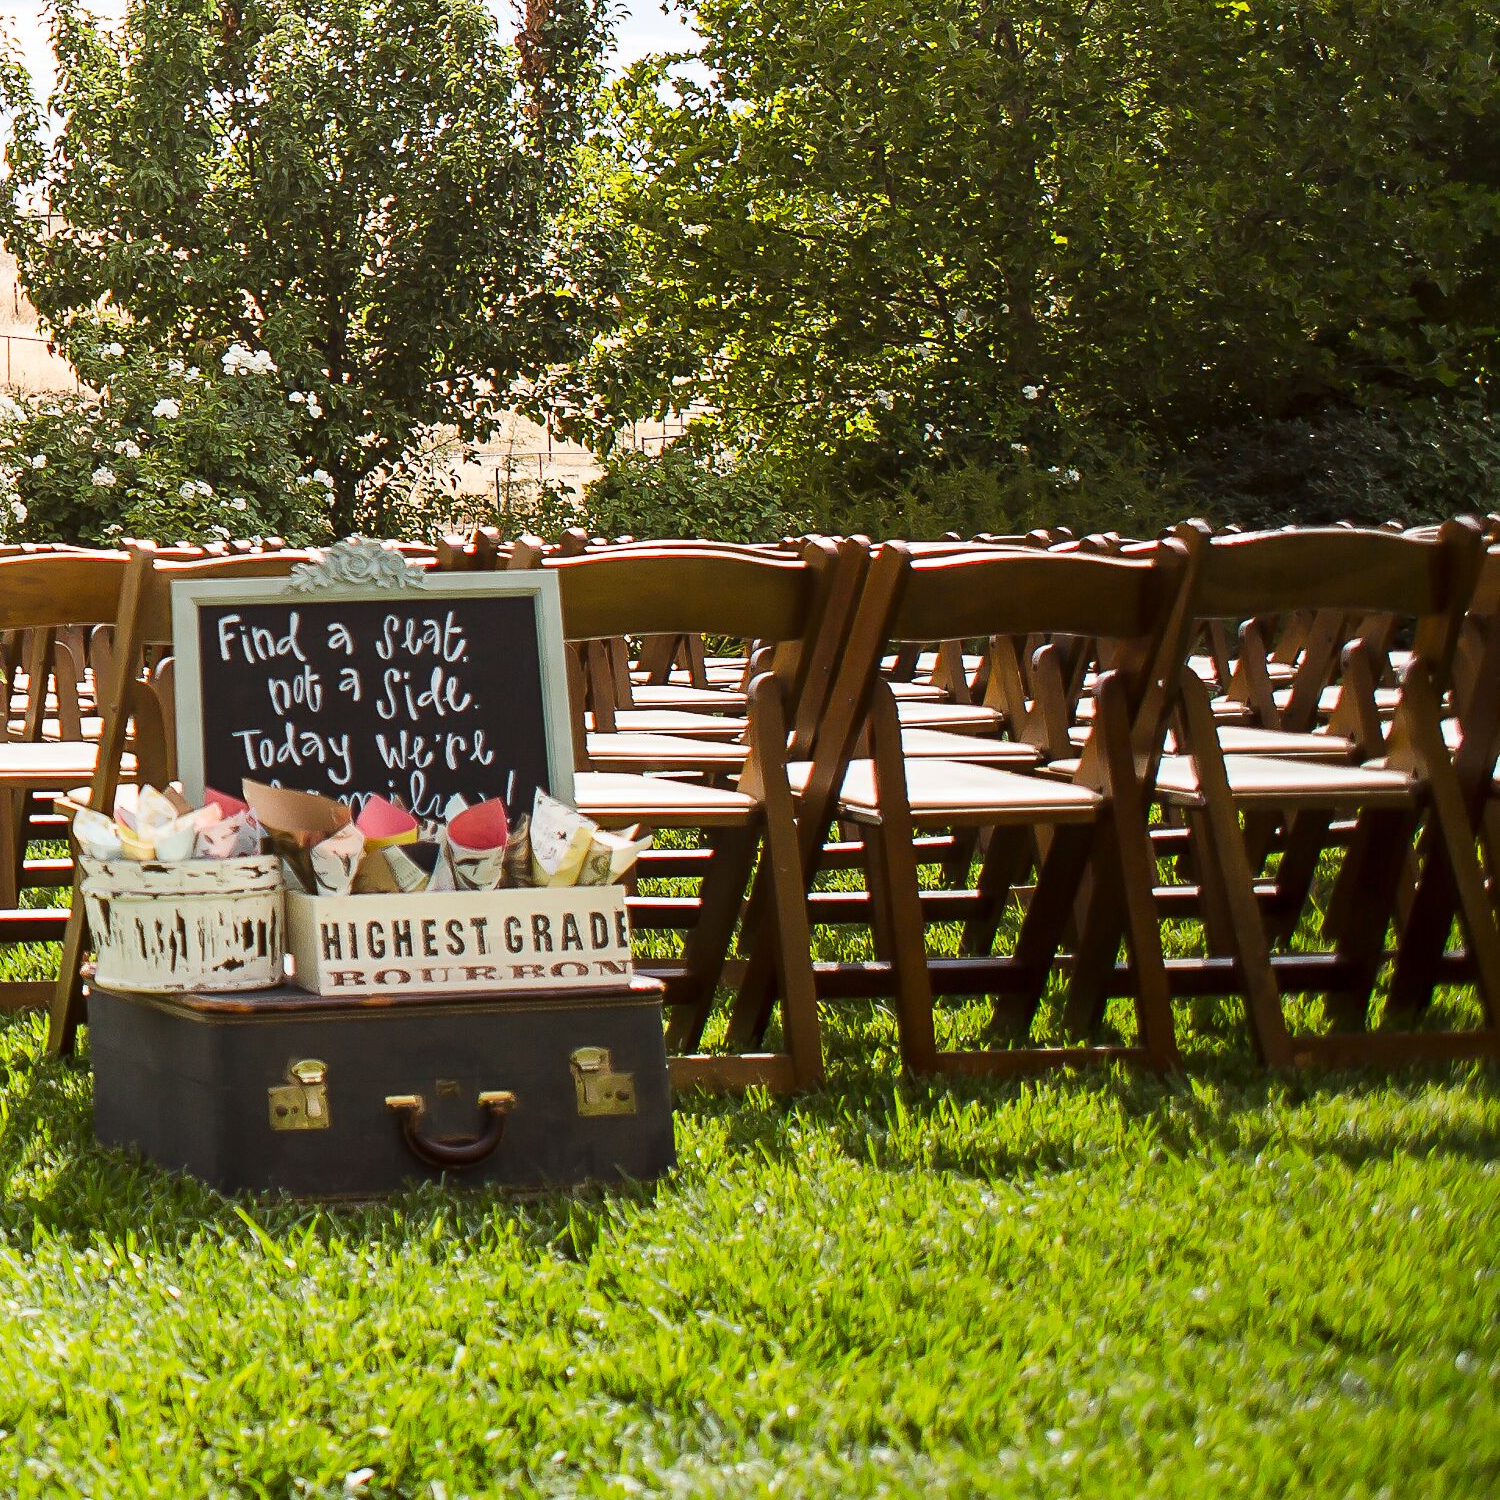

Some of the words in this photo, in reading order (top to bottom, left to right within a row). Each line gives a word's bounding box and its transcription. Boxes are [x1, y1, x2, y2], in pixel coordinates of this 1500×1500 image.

[218, 611, 307, 663] Find
[327, 622, 354, 654] a
[268, 664, 323, 715] not
[338, 667, 361, 701] a
[231, 721, 351, 785] Today
[319, 915, 489, 961] HIGHEST
[503, 909, 628, 954] GRADE
[326, 958, 632, 987] BOURBON
